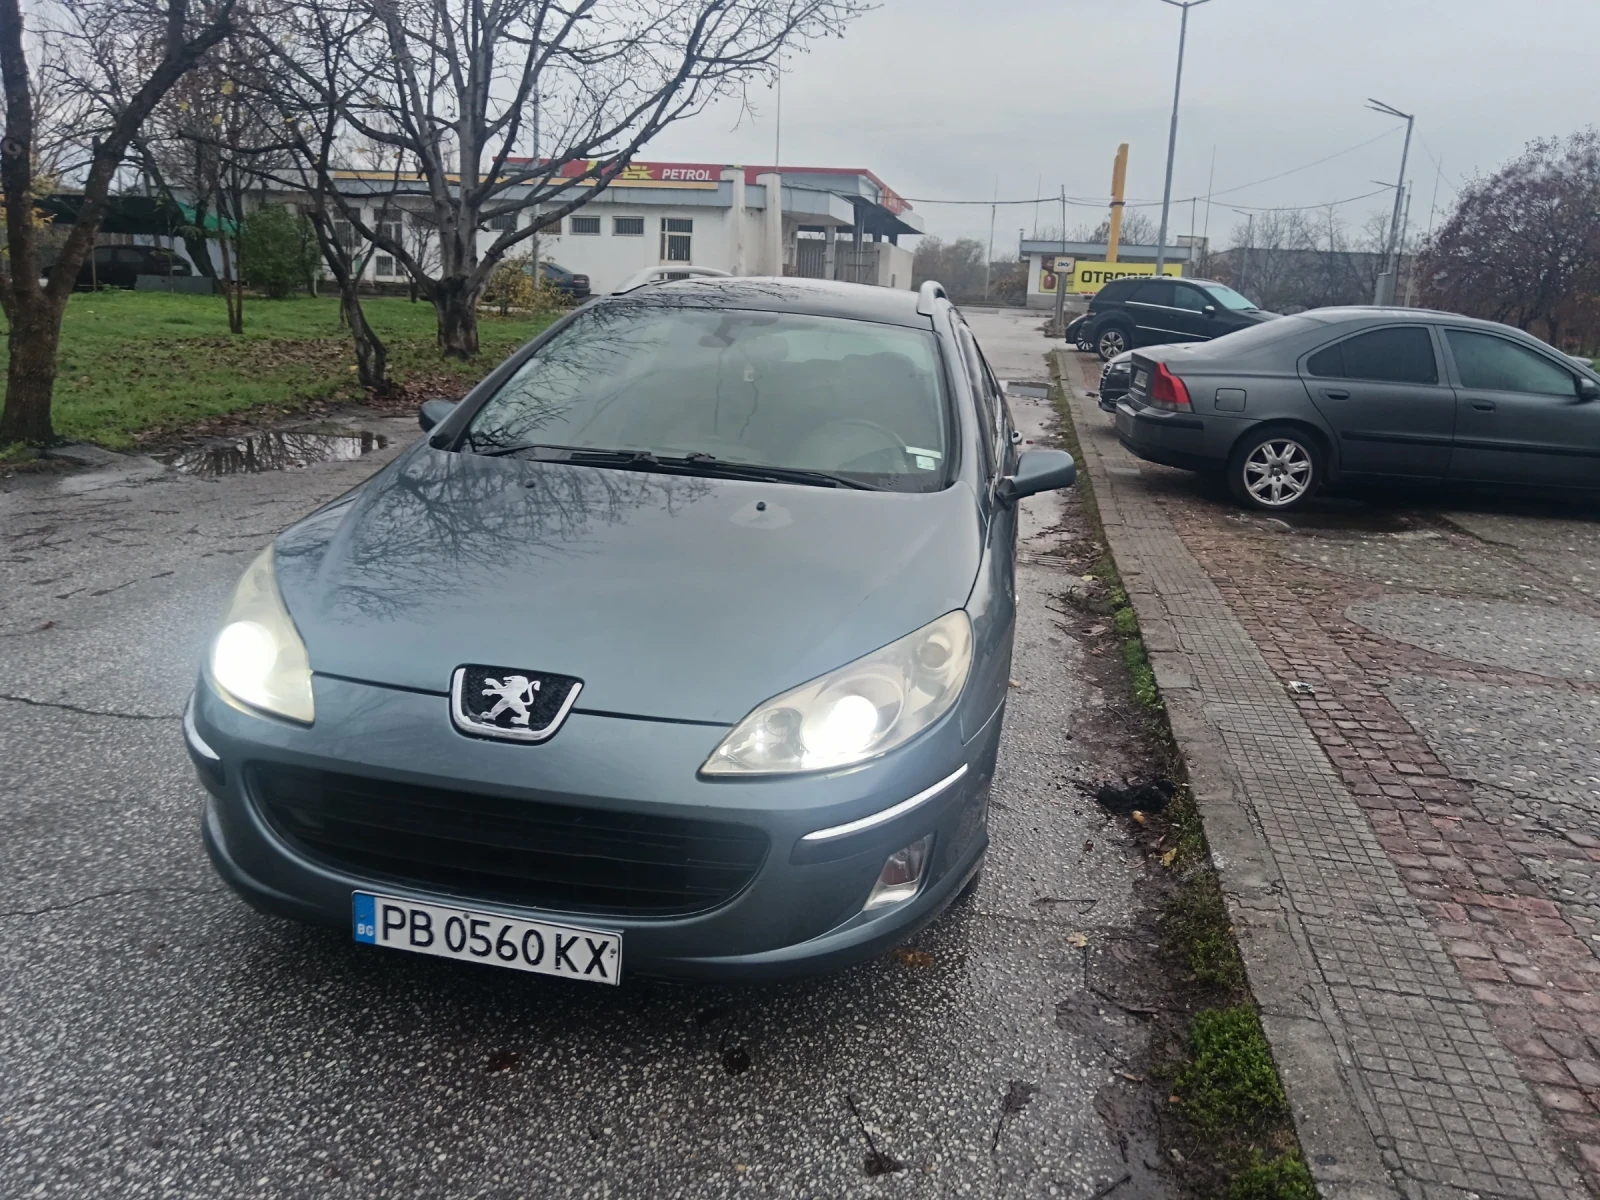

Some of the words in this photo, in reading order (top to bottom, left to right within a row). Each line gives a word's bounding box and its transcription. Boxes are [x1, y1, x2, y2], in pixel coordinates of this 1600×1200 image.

[662, 169, 712, 180] PETROL
[357, 923, 375, 937] BG
[382, 904, 434, 947] PB
[444, 915, 545, 966] 0560
[554, 933, 610, 978] KX
